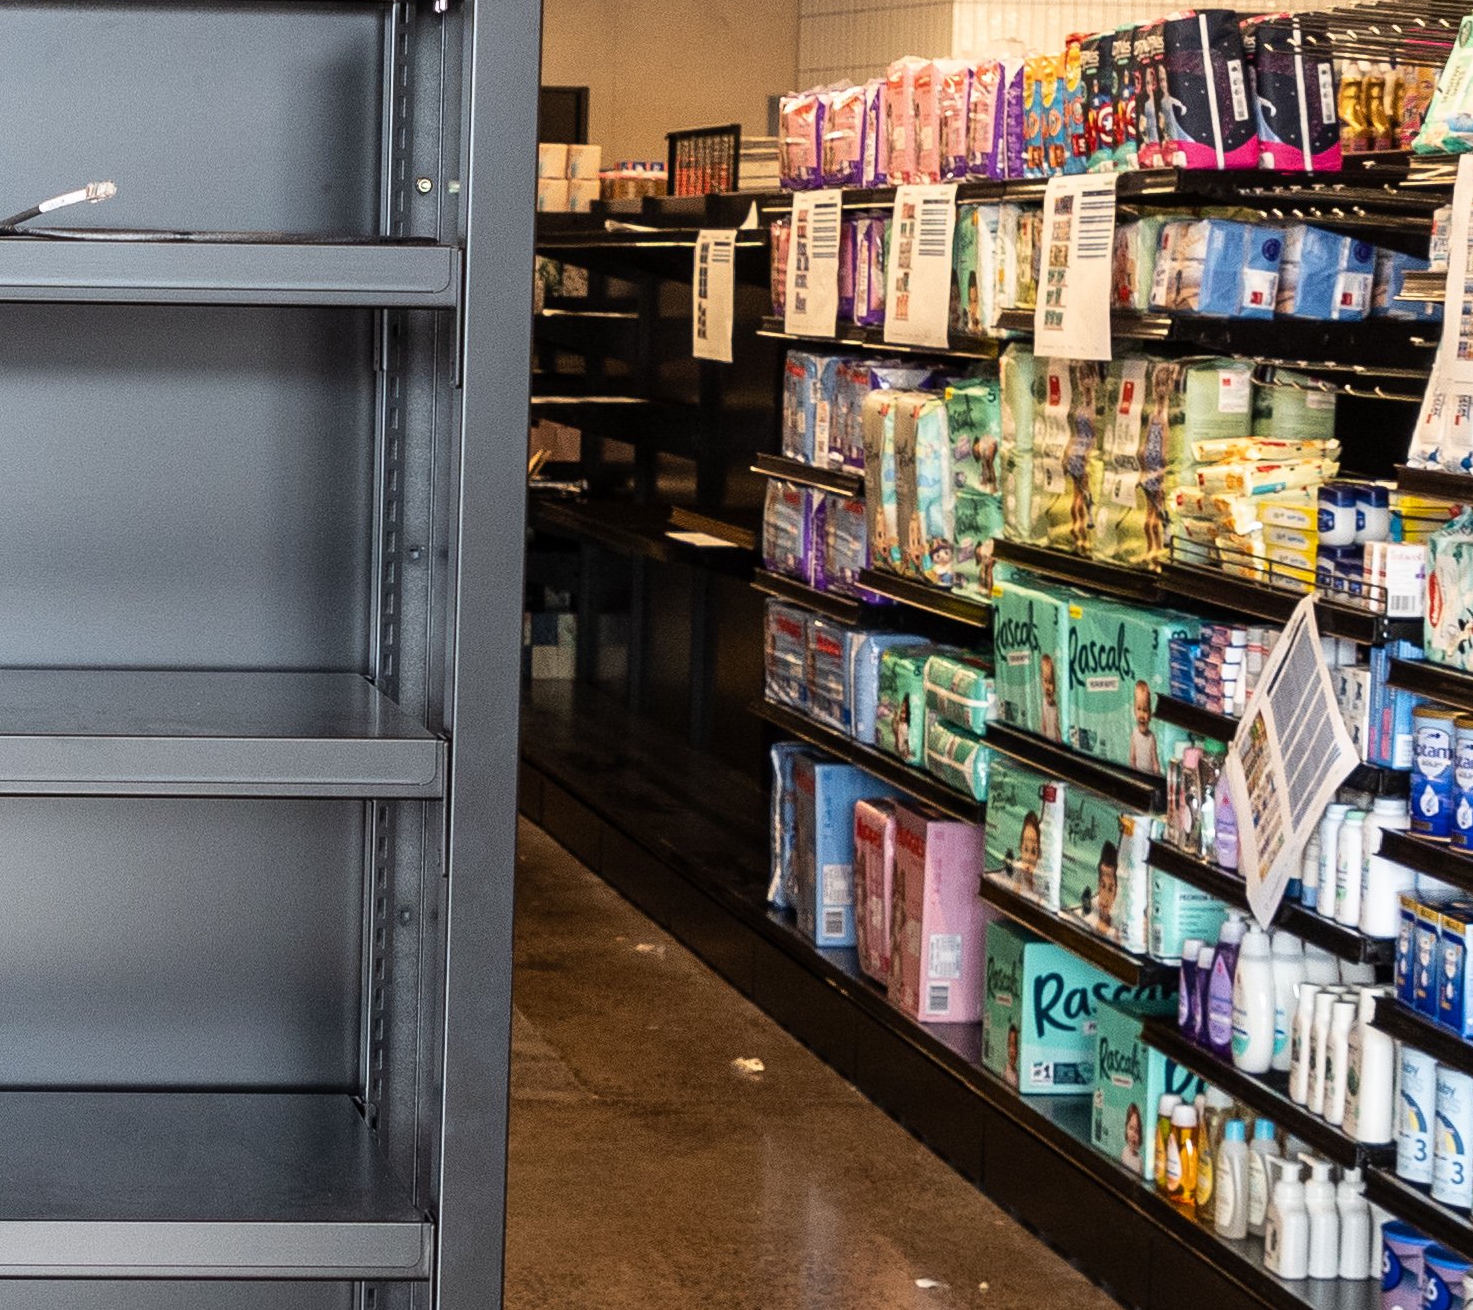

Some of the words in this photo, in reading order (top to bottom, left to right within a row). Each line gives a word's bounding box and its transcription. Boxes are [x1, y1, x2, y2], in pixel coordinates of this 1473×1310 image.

[994, 600, 1041, 662] Rascals
[1068, 622, 1135, 690] Rascals
[1099, 1037, 1144, 1084] Rascals
[1414, 1139, 1428, 1163] 3
[1450, 1161, 1465, 1186] 3
